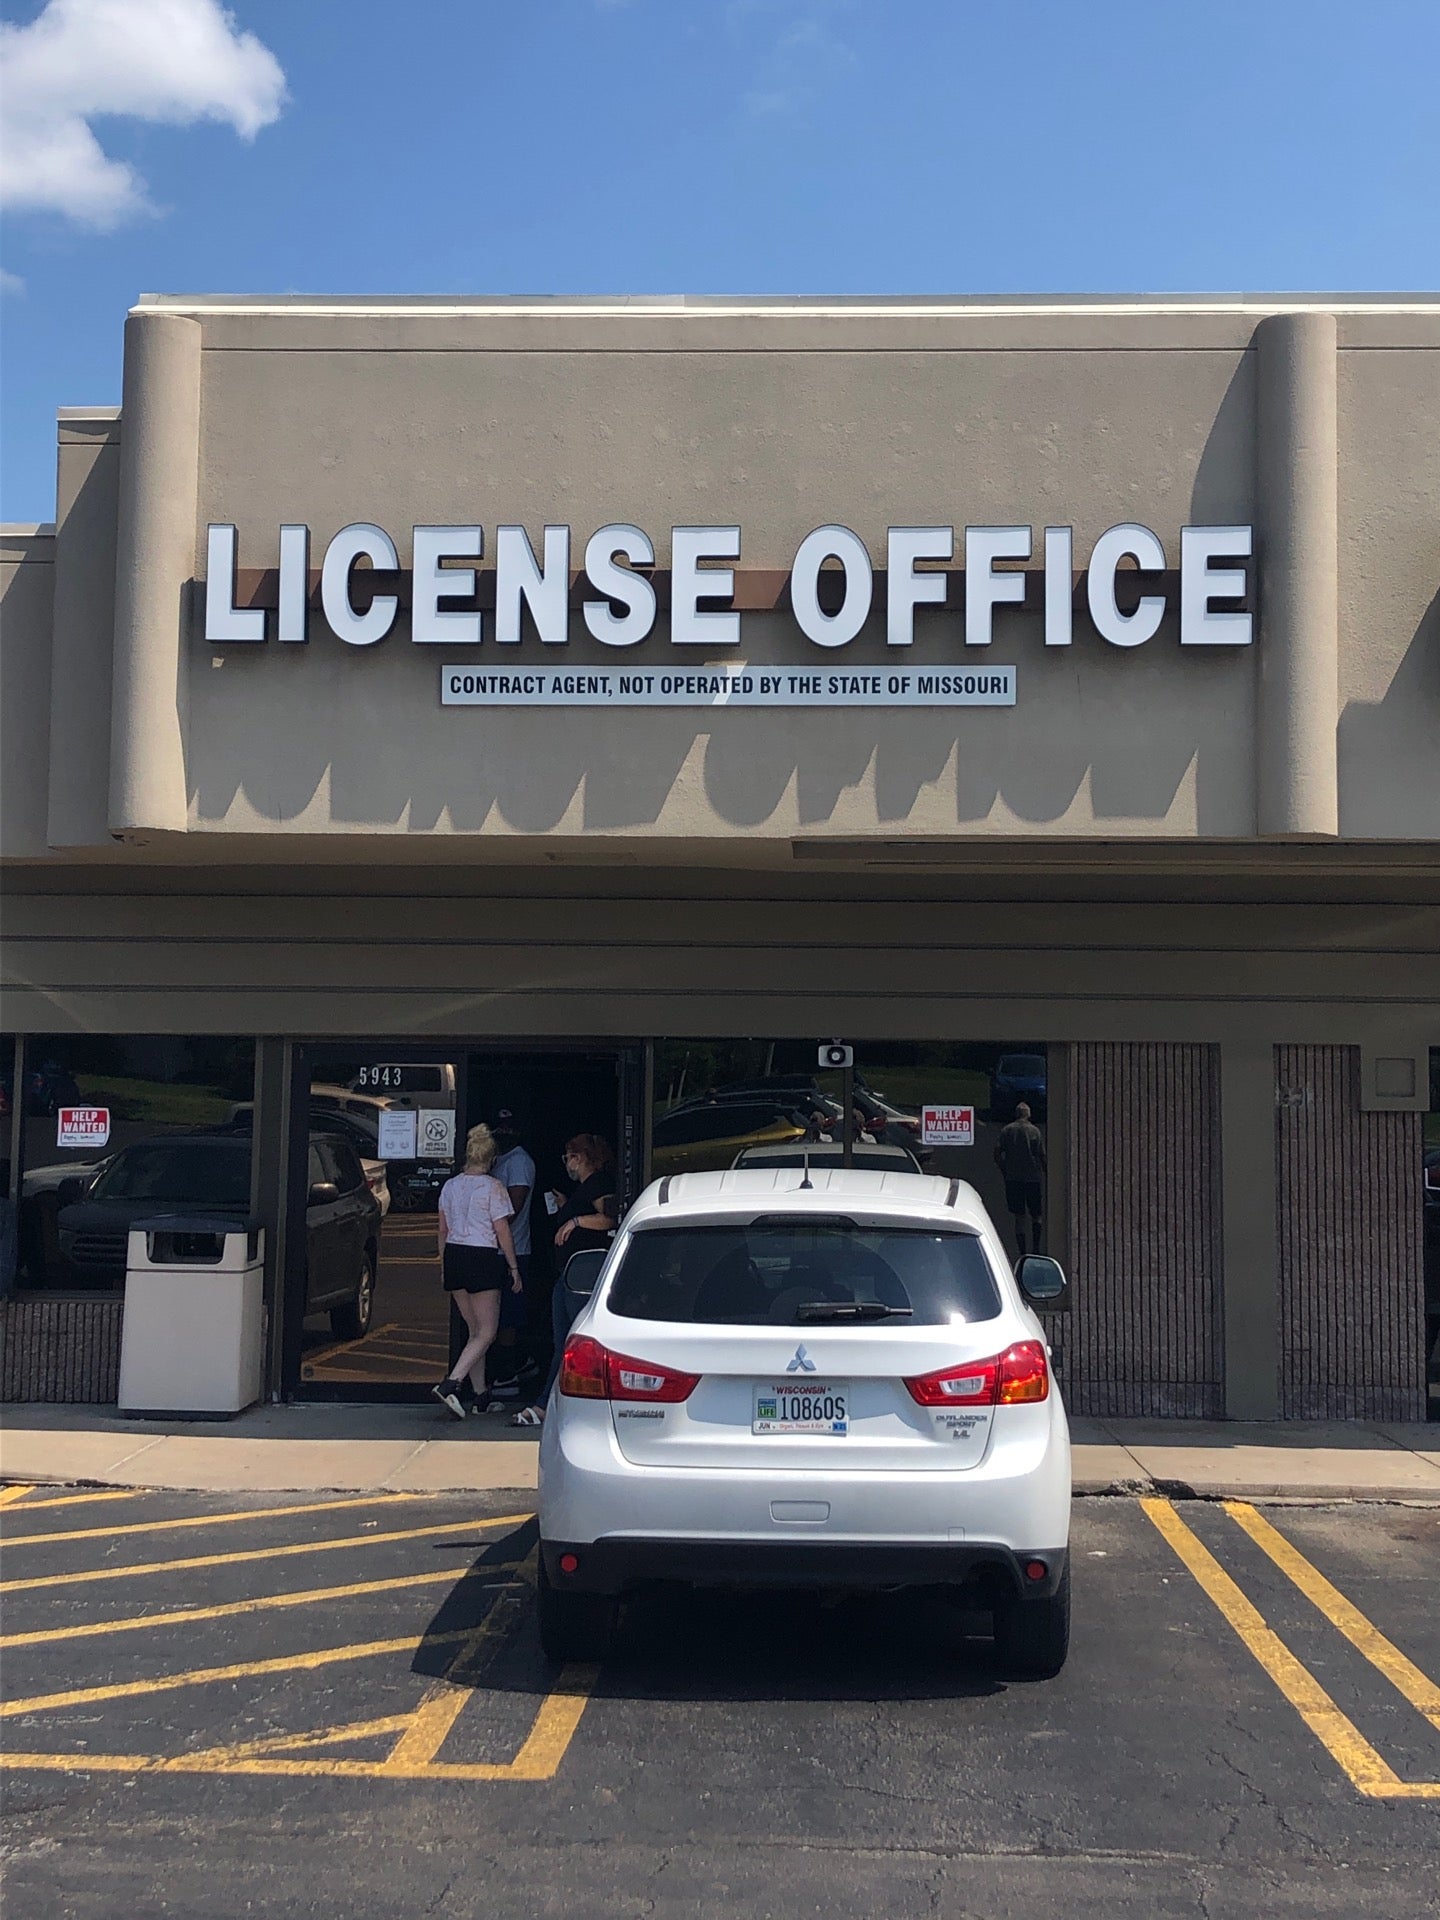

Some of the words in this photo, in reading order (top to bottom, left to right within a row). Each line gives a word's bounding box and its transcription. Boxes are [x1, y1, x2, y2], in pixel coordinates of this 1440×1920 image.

[204, 523, 742, 646] LICENSE
[790, 522, 1254, 648] OFFICE
[450, 675, 546, 694] CONTRACT
[551, 675, 613, 697] AGENT,
[619, 675, 655, 694] NOT
[660, 675, 754, 694] OPERATED
[759, 675, 782, 694] BY
[787, 675, 822, 694] THE
[828, 675, 881, 694] STATE
[888, 675, 911, 694] OF
[917, 675, 1009, 694] MISSOURI
[359, 1066, 401, 1086] 5943
[71, 1111, 98, 1122] HELP
[935, 1110, 962, 1120] HELP
[63, 1122, 106, 1132] WANTED
[927, 1120, 970, 1131] WANTED
[776, 1385, 827, 1395] WISCONSIN
[759, 1406, 775, 1417] LIFE
[780, 1396, 845, 1421] 10860S
